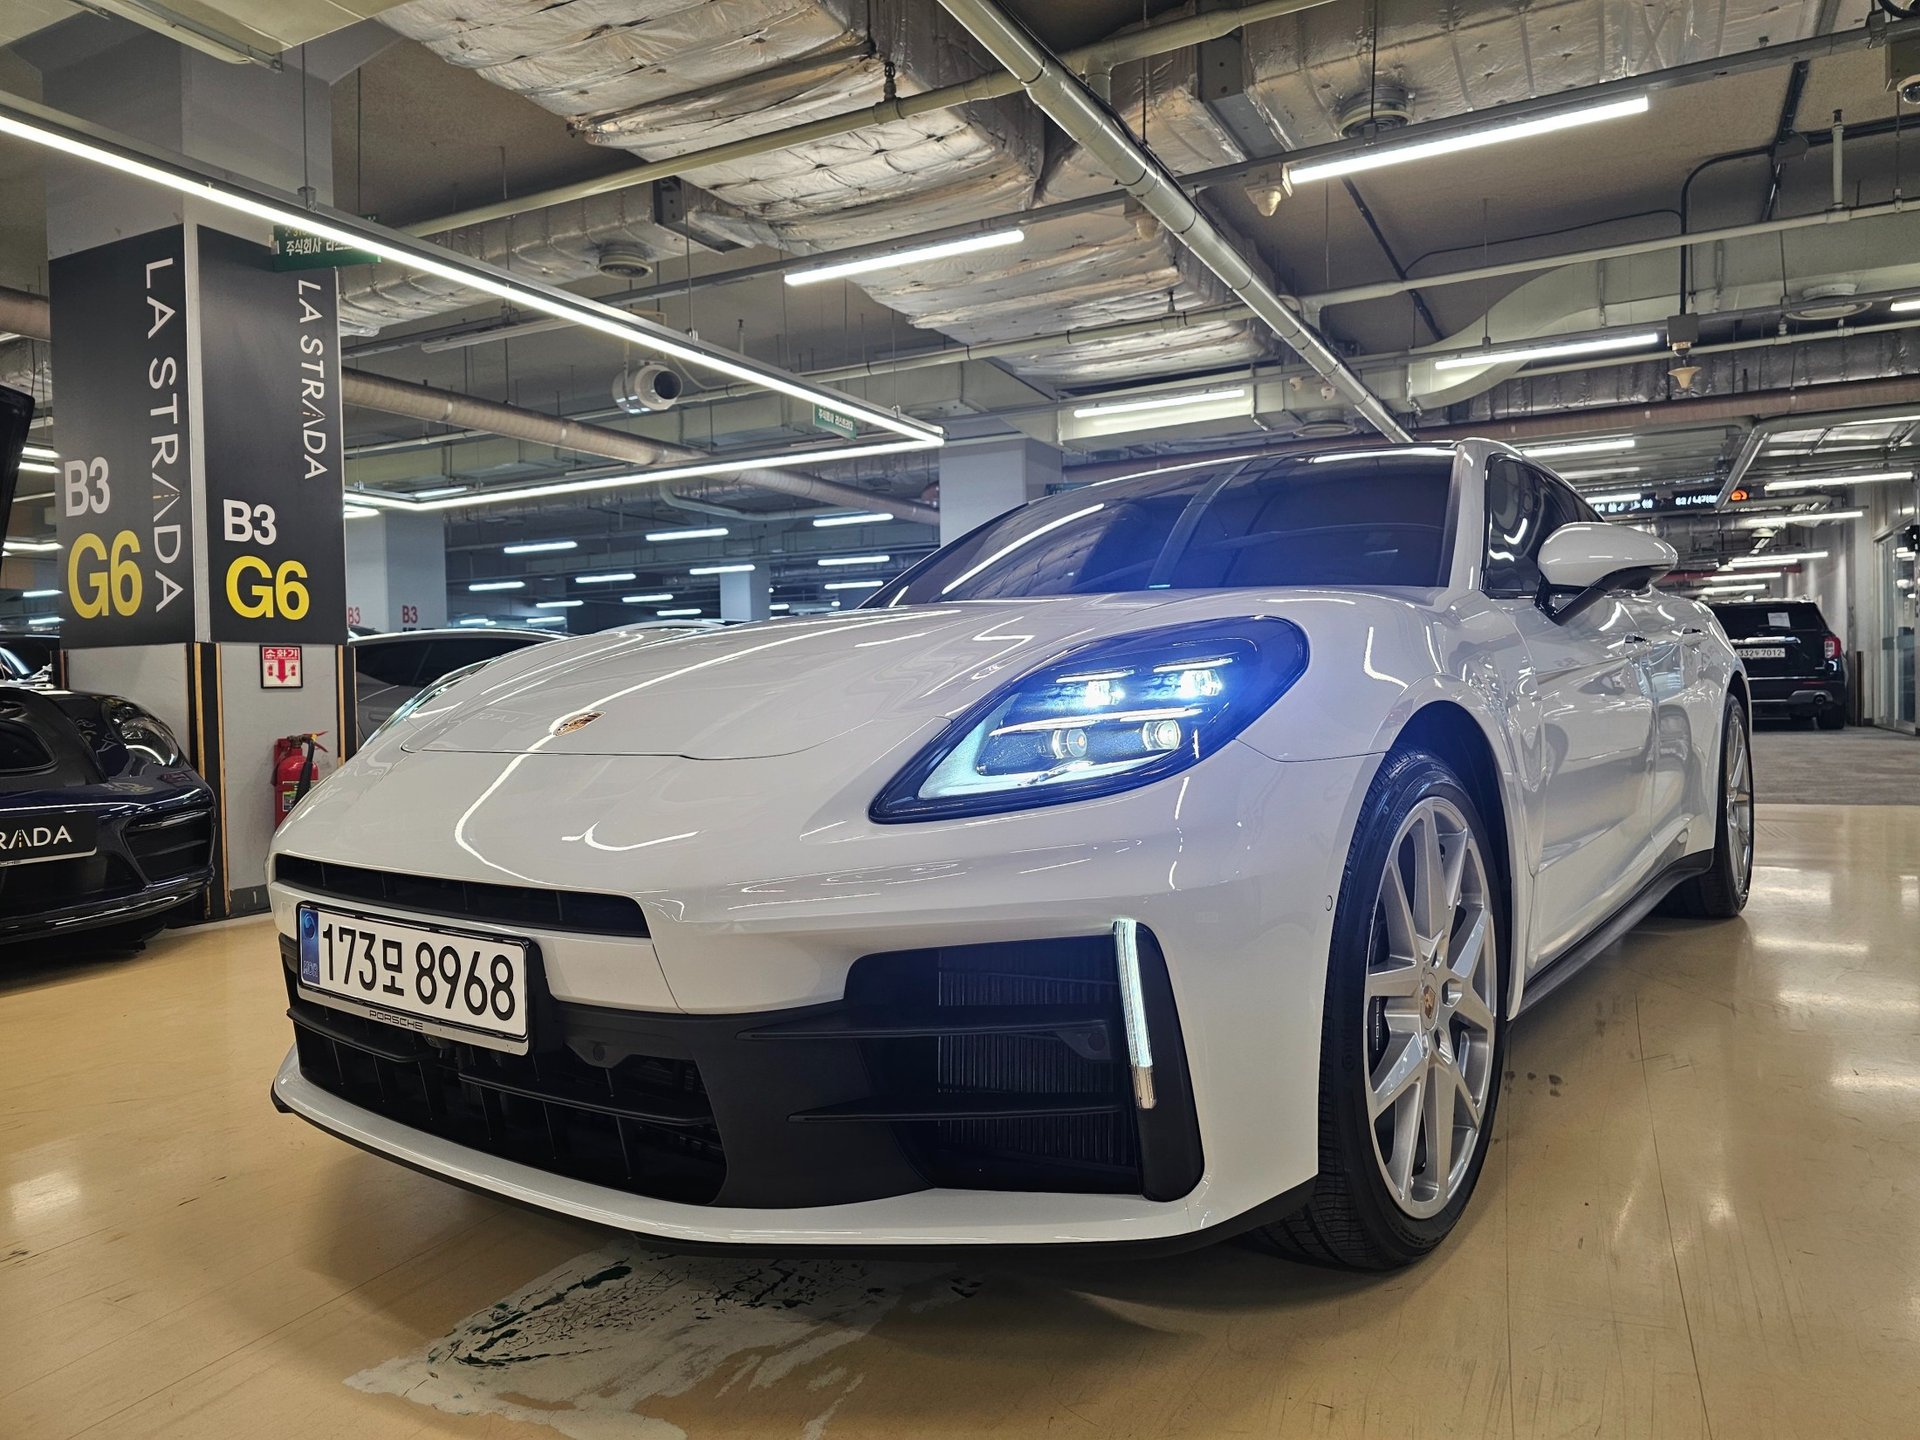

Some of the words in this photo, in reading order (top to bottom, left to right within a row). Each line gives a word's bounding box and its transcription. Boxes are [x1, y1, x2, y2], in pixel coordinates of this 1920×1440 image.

[146, 258, 175, 339] LA
[298, 279, 322, 323] LA
[300, 334, 328, 479] STRADA
[65, 456, 110, 517] B3
[149, 357, 183, 612] STRADA
[224, 499, 276, 545] B3
[68, 530, 142, 619] G6
[226, 556, 309, 620] G6
[348, 606, 360, 624] B3
[402, 605, 418, 624] B3
[265, 649, 298, 659] 소화기
[322, 923, 404, 998] 173모
[415, 941, 516, 1021] 8968
[369, 1009, 424, 1031] PORSCHE
